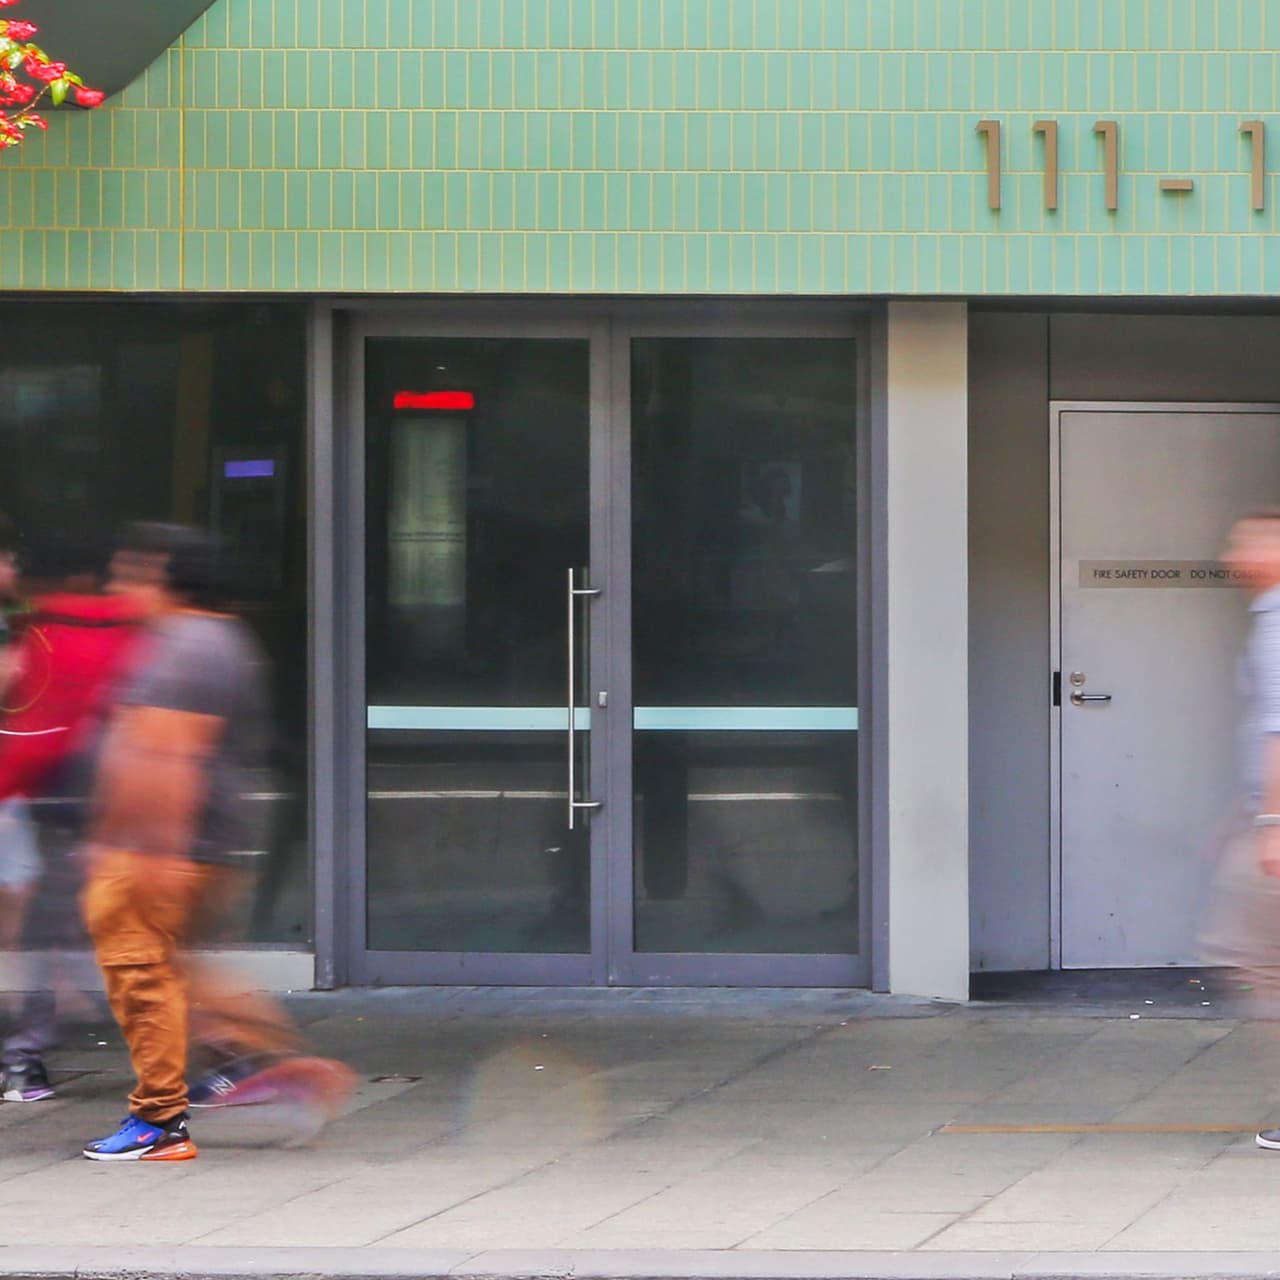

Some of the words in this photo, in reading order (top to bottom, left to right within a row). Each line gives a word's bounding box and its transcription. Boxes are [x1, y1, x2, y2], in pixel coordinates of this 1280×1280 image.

[1094, 569, 1112, 579] FIRE
[1115, 569, 1147, 579] SAFETY
[1151, 569, 1180, 579] DOOR
[1190, 569, 1206, 579] DO
[1209, 569, 1230, 579] NOT
